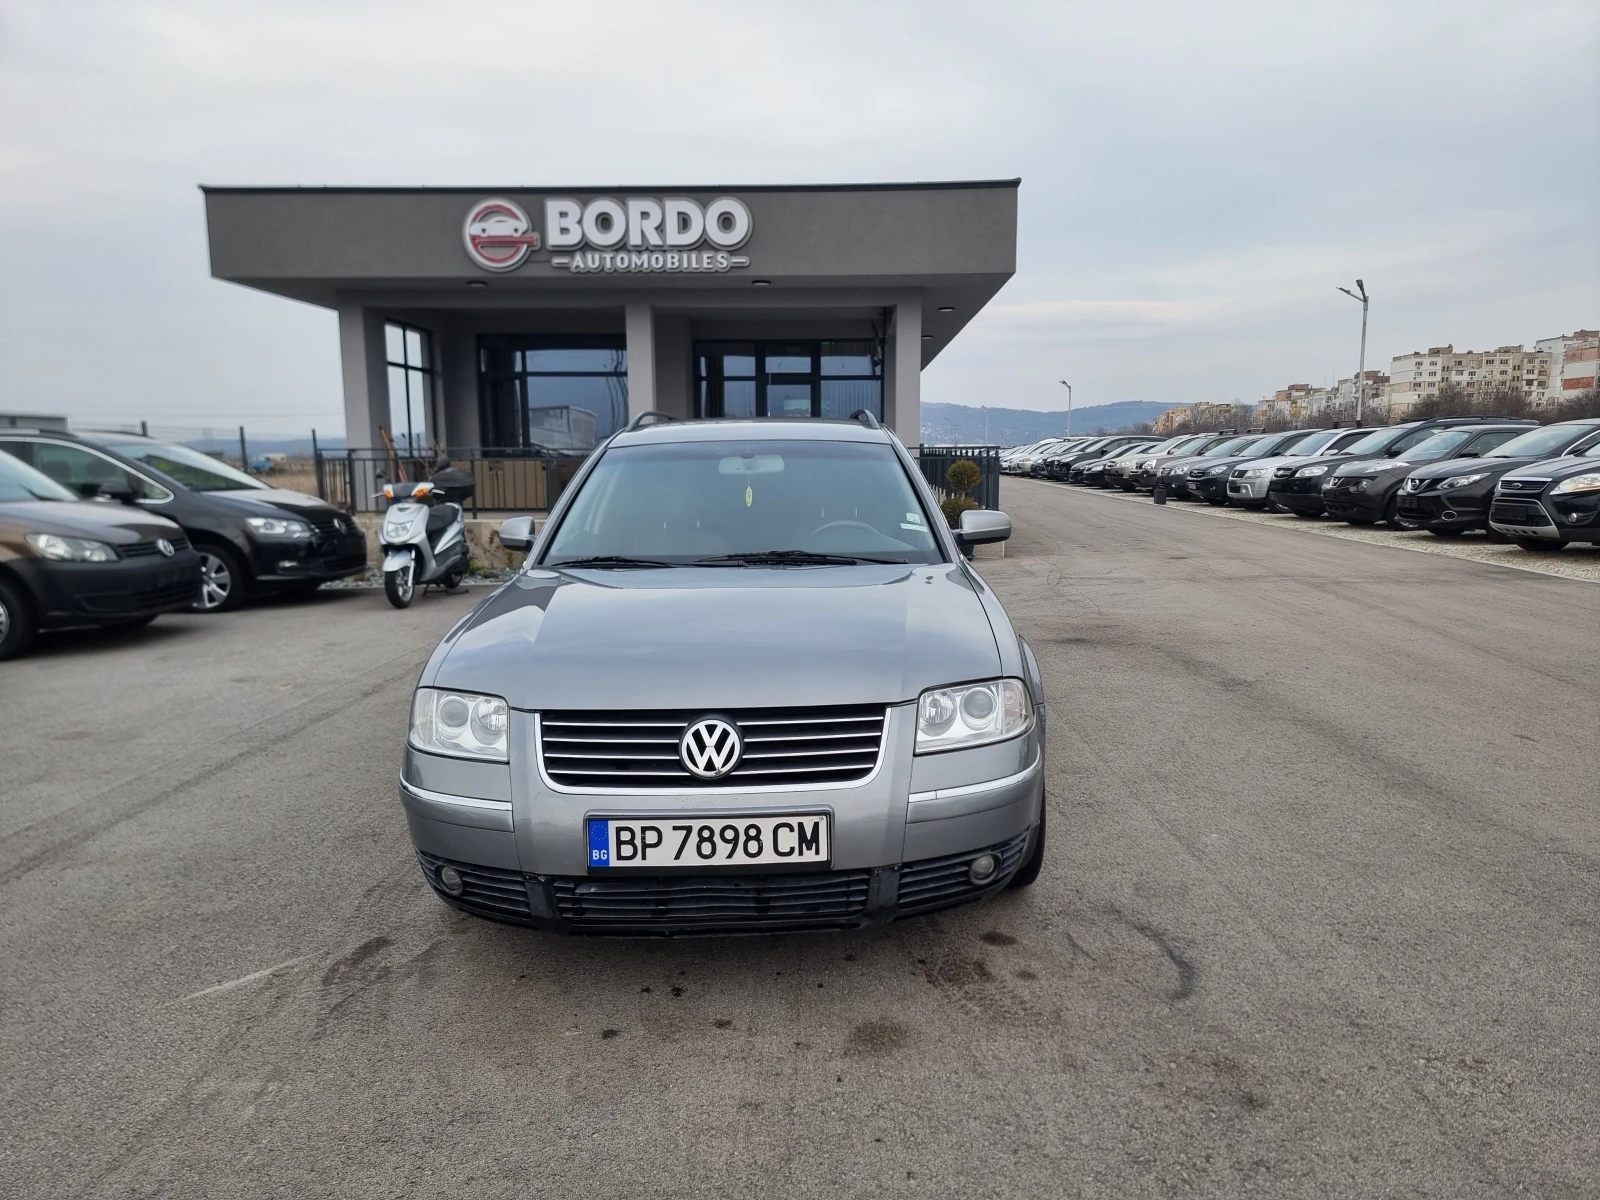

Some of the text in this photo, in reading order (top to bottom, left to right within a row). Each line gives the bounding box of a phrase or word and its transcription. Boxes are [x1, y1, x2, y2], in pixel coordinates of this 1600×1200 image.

[547, 199, 749, 245] BORDO
[572, 254, 729, 269] AUTOMOBILES
[681, 719, 741, 778] VW
[592, 849, 608, 860] BG
[615, 822, 820, 861] BP 7898 CM
